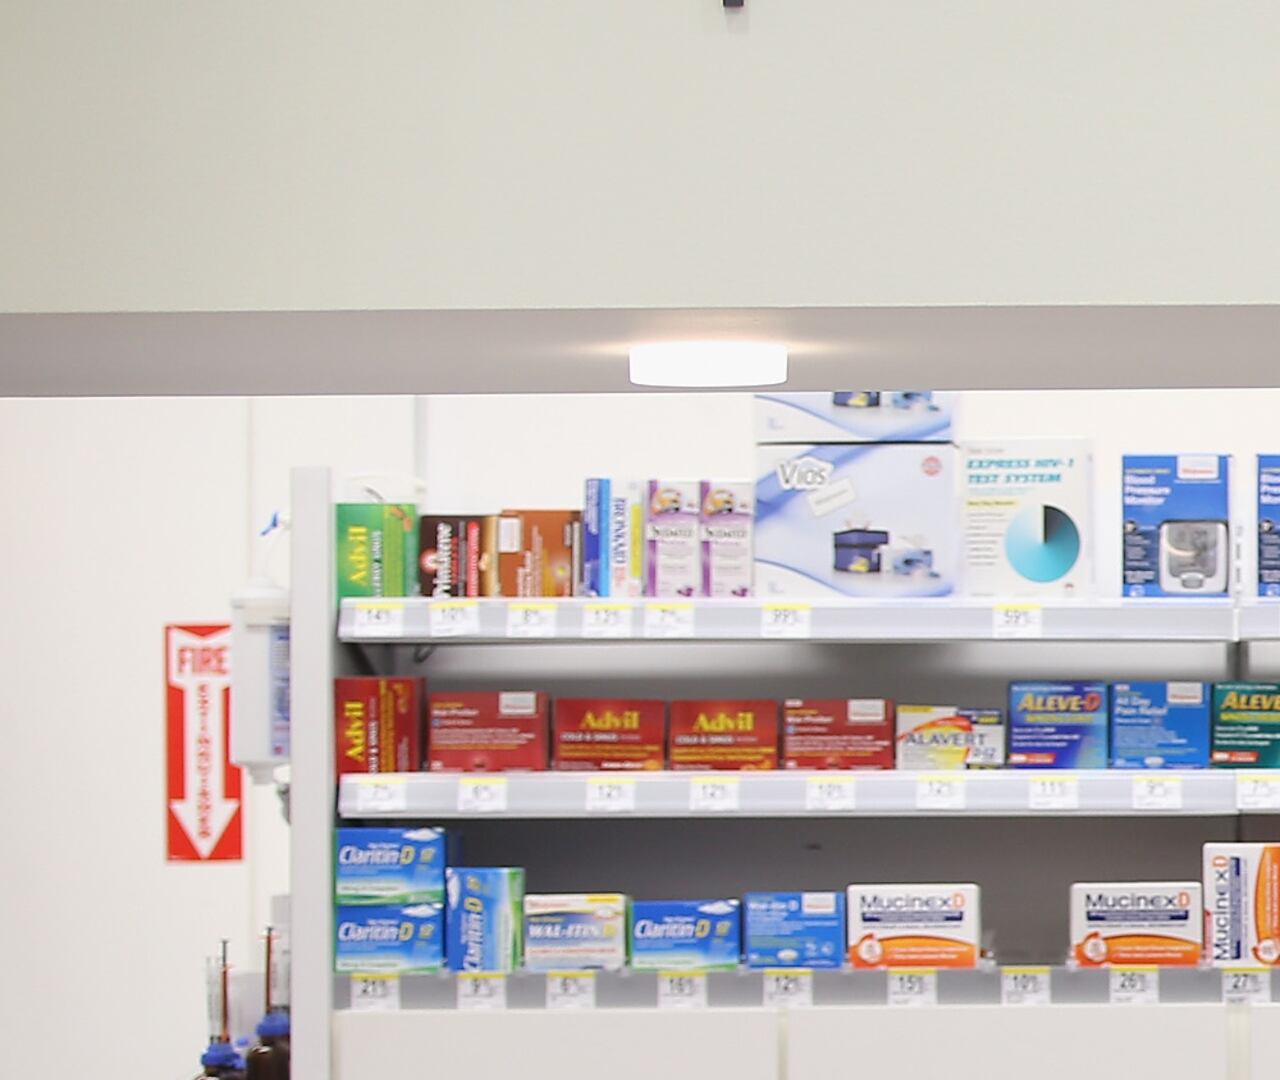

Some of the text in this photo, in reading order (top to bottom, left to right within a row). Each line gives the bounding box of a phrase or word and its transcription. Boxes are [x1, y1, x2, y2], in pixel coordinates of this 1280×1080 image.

[967, 458, 1075, 469] EXPRESS HIV-1
[779, 464, 827, 486] Vios
[967, 473, 1062, 484] TEST SYSTEM
[349, 526, 367, 587] Advil
[178, 647, 227, 675] FIRE
[1017, 692, 1101, 712] ALEVE-D
[581, 710, 640, 729] Advil
[693, 711, 754, 731] Advil
[344, 702, 365, 761] Advil
[905, 733, 986, 746] ALAVERT
[339, 846, 400, 865] Claritin
[860, 893, 953, 909] Mucinex
[1084, 892, 1179, 909] Mucinex
[338, 923, 399, 942] Claritin
[634, 919, 695, 939] Claritin
